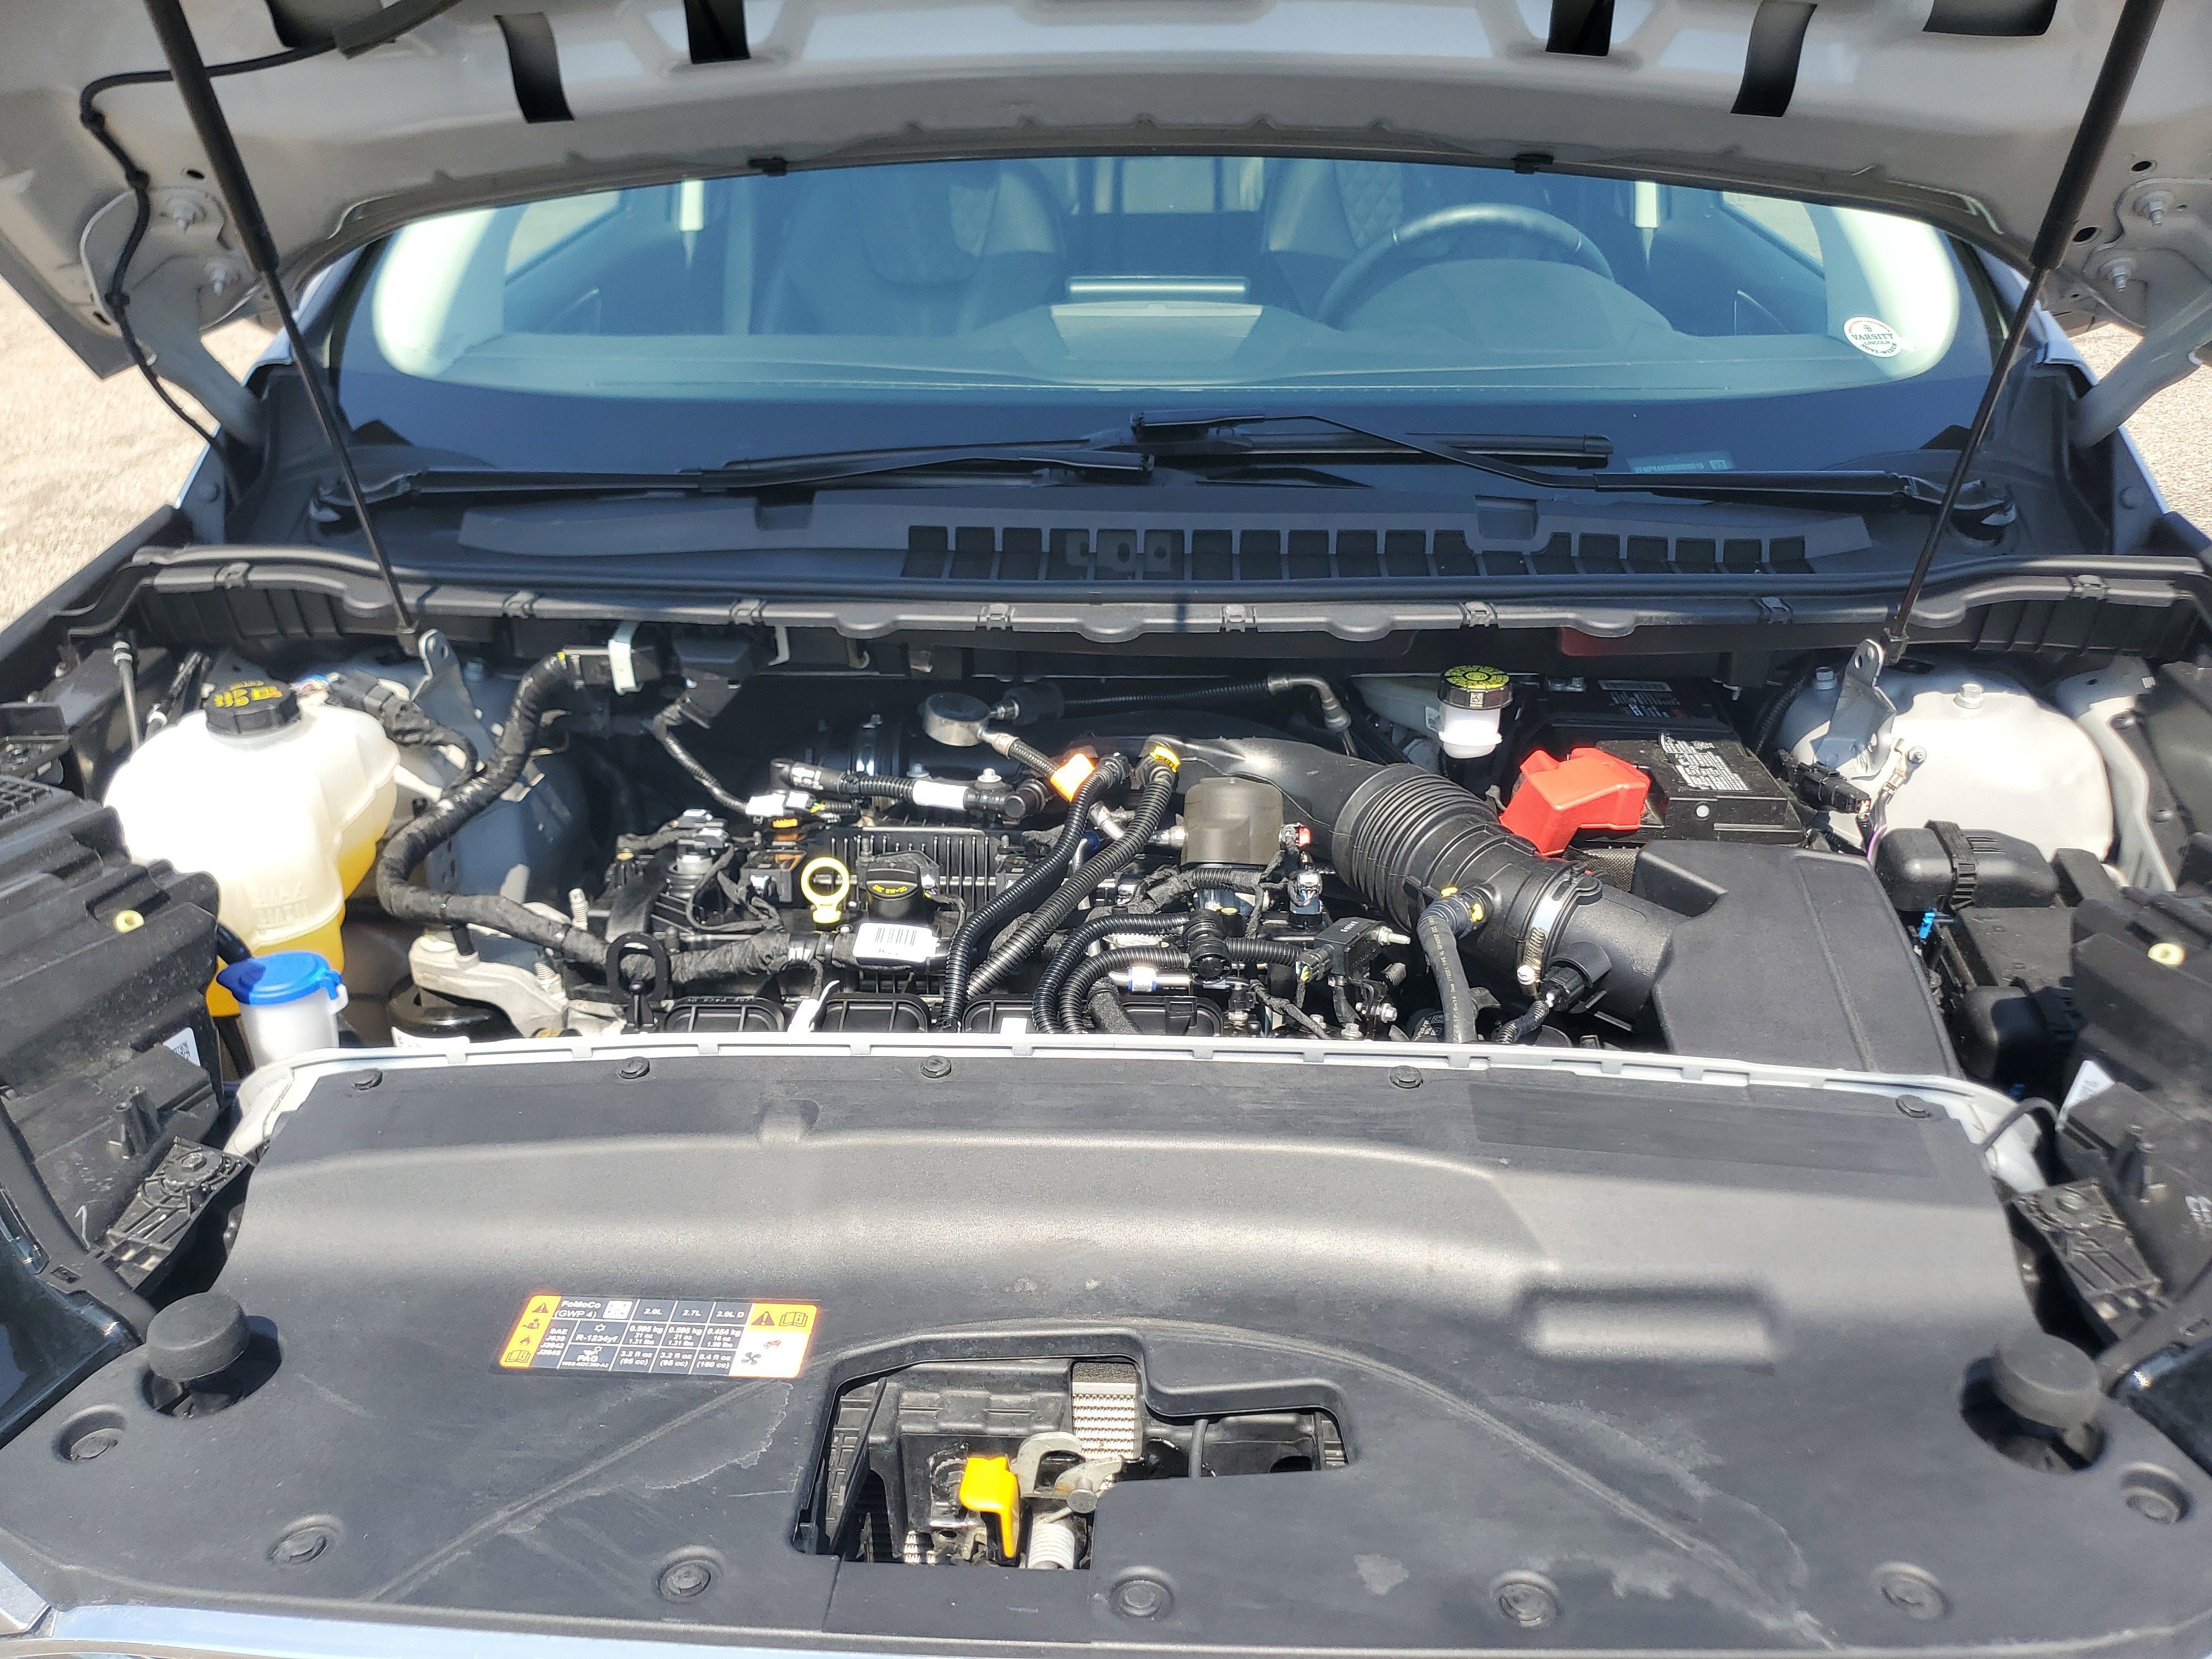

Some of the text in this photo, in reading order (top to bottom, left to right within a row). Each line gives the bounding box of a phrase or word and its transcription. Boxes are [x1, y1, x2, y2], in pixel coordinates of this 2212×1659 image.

[561, 1300, 601, 1309] FoMoCo
[555, 1310, 597, 1319] (GWP 4)
[575, 1334, 619, 1343] R-1234yf
